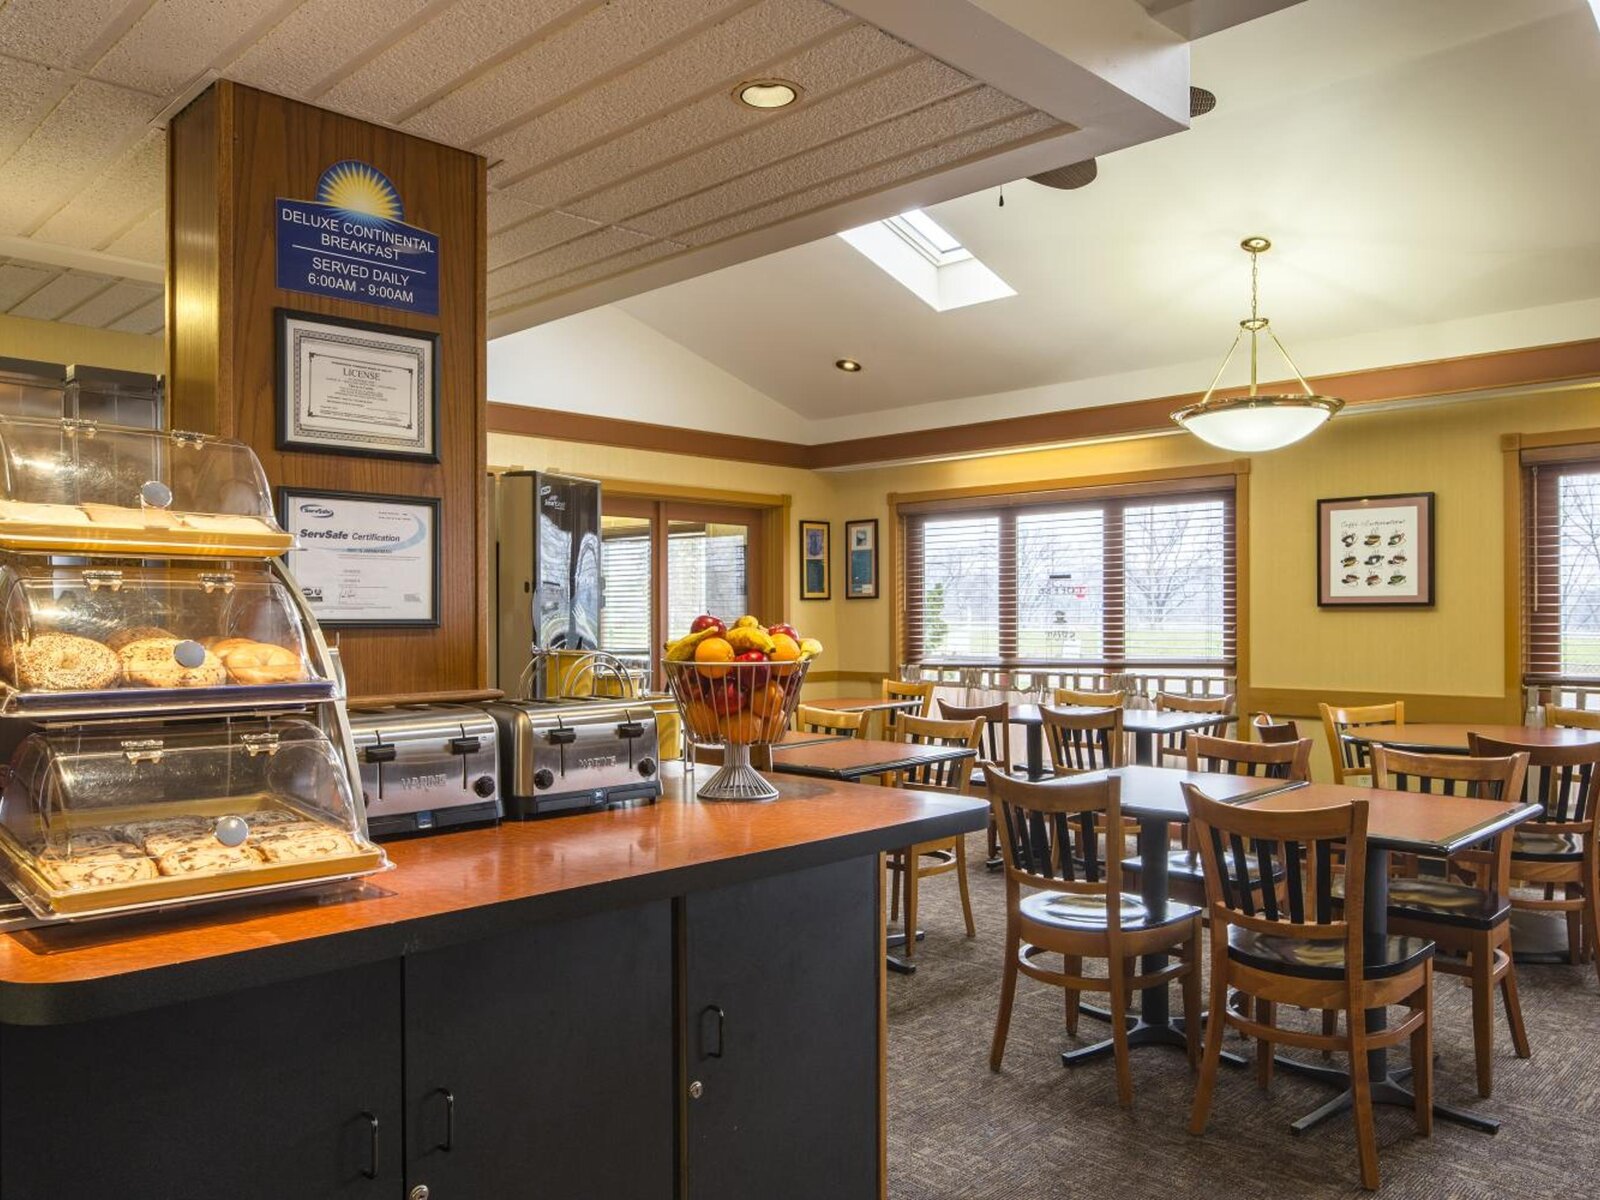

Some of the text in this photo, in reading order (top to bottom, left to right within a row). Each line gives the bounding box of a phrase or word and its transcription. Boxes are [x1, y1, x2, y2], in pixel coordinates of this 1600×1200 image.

[282, 208, 435, 253] DELUXE CONTINENTAL
[321, 233, 400, 261] BREAKFAST
[312, 257, 410, 287] SERVED DAILY
[308, 273, 356, 292] 6:00AM
[368, 283, 414, 303] 9:00AM
[343, 367, 381, 381] LICENSE
[300, 528, 400, 542] ServSafe Certification
